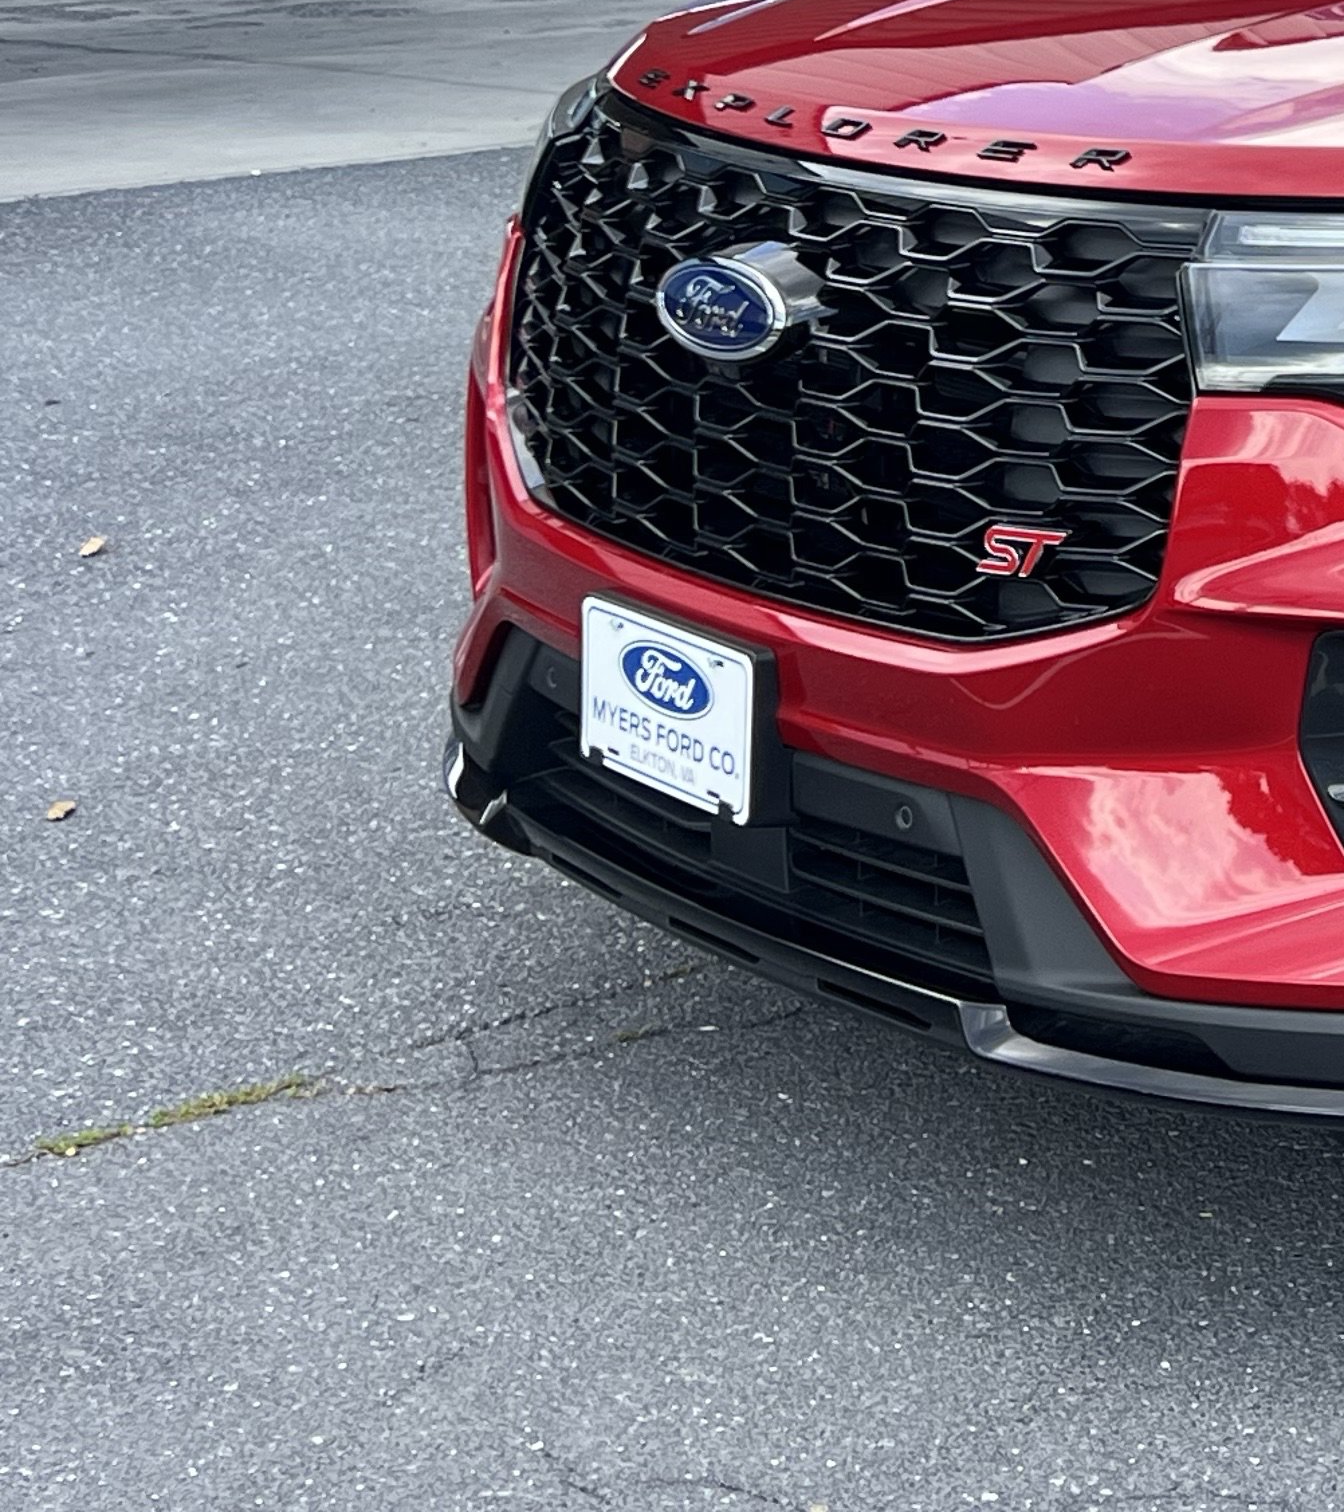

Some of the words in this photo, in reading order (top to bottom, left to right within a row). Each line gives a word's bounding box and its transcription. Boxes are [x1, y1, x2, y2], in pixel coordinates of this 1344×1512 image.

[637, 67, 1133, 172] EXPLORER
[676, 275, 749, 338] Ford
[976, 523, 1069, 578] ST
[634, 648, 697, 711] Ford
[592, 695, 651, 742] MYERS
[656, 723, 705, 764] FORD
[709, 745, 740, 780] CO.
[681, 765, 696, 785] VA
